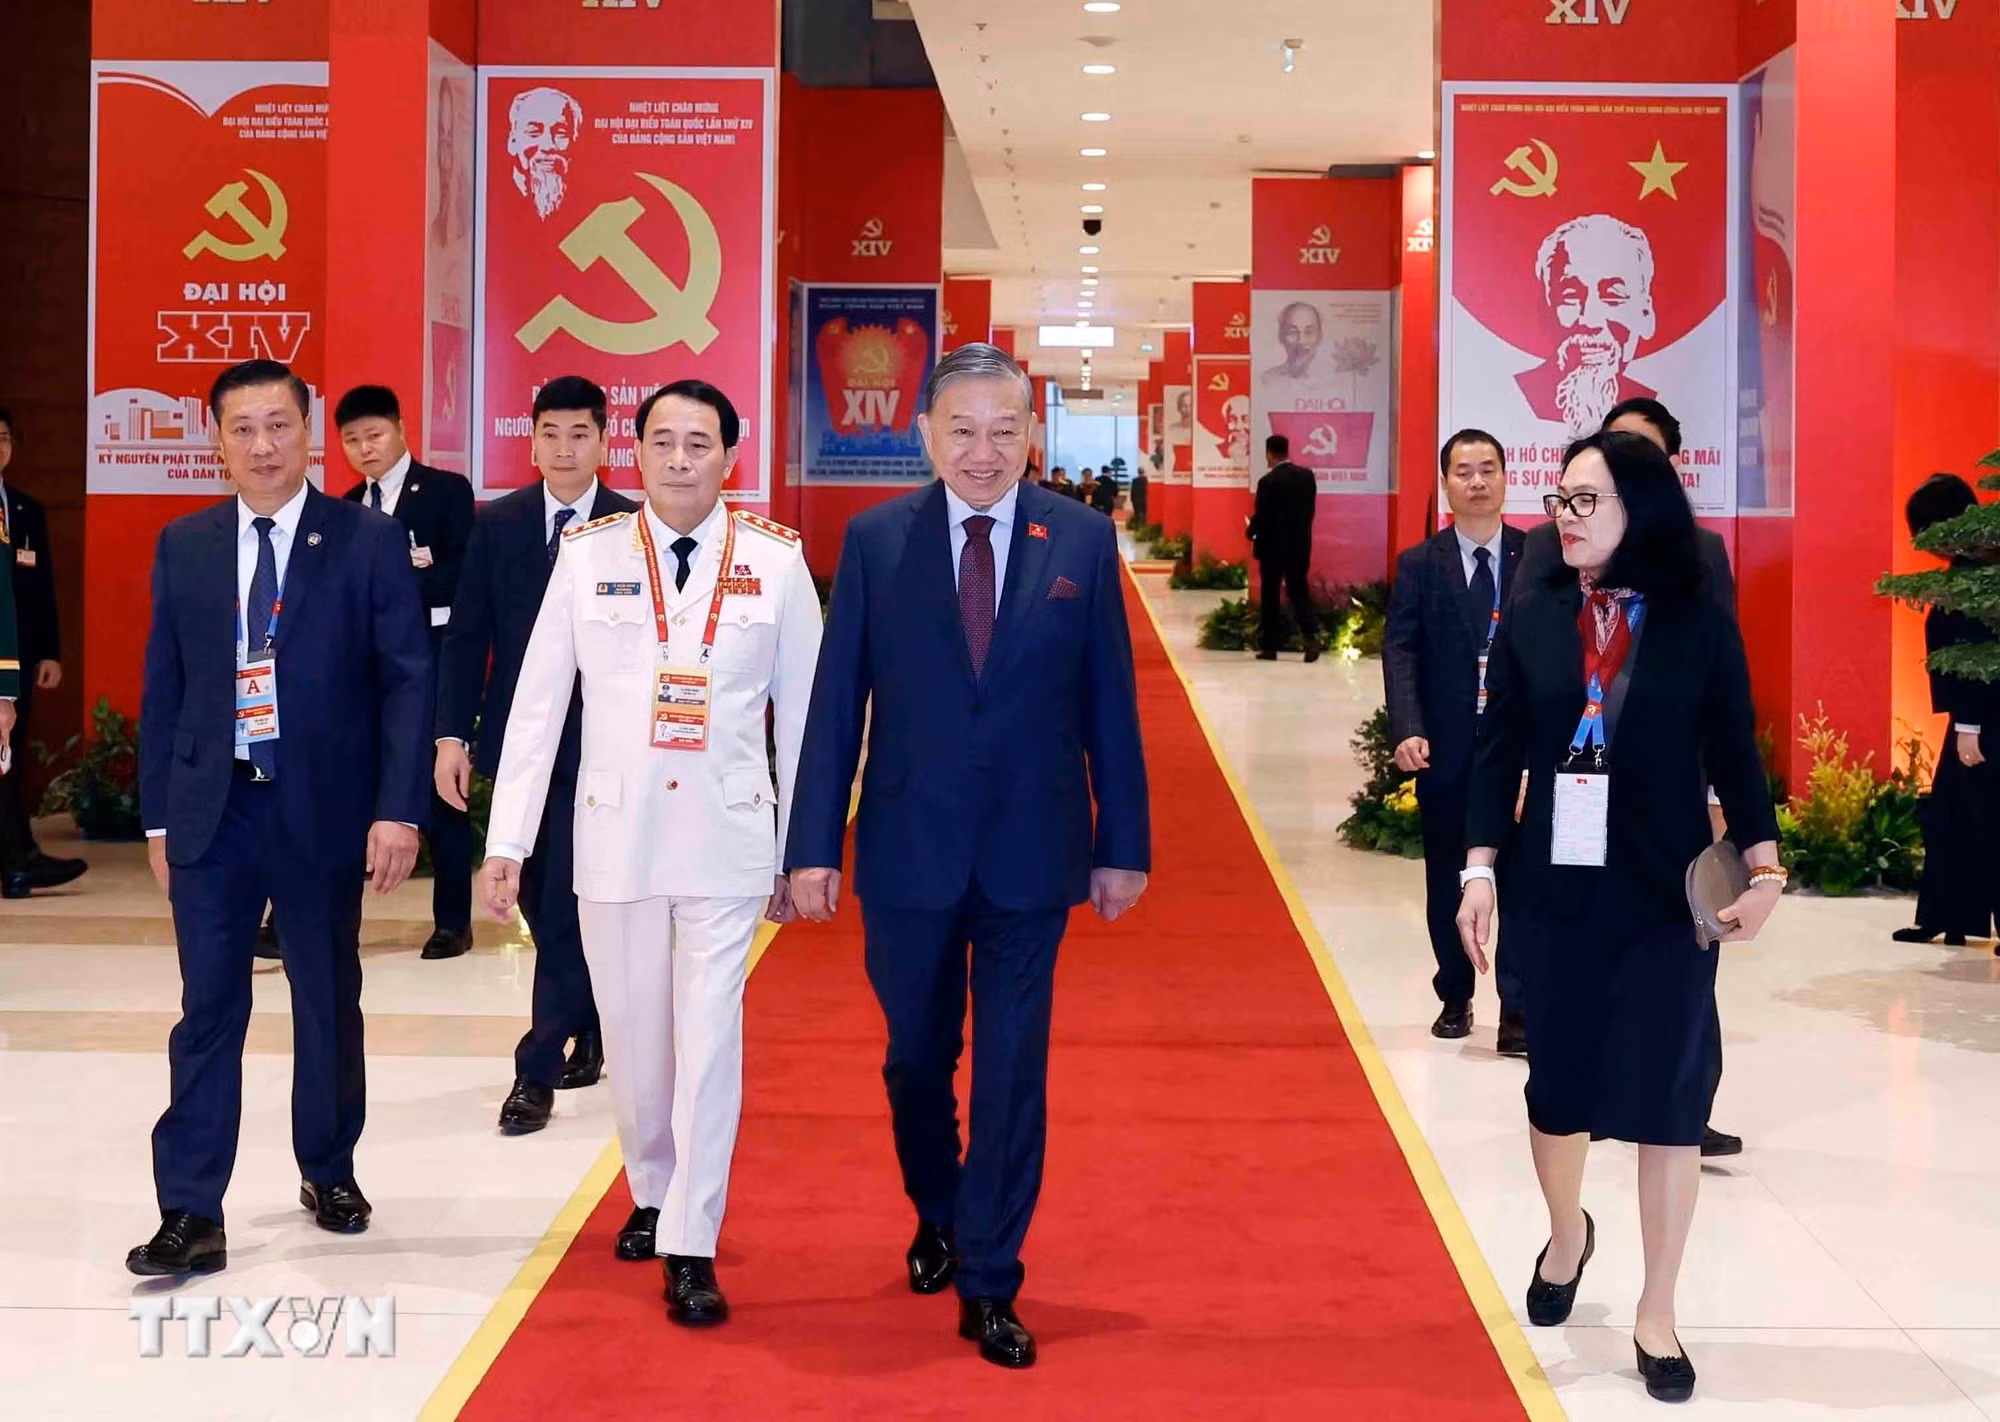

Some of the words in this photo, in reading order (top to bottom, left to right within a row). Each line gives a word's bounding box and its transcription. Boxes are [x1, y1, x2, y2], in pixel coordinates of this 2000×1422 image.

[1300, 248, 1341, 264] XIV
[184, 282, 229, 304] ĐẠI
[239, 280, 286, 305] HỘI
[611, 378, 637, 405] SẢN
[842, 389, 900, 426] XIV
[247, 679, 260, 694] A
